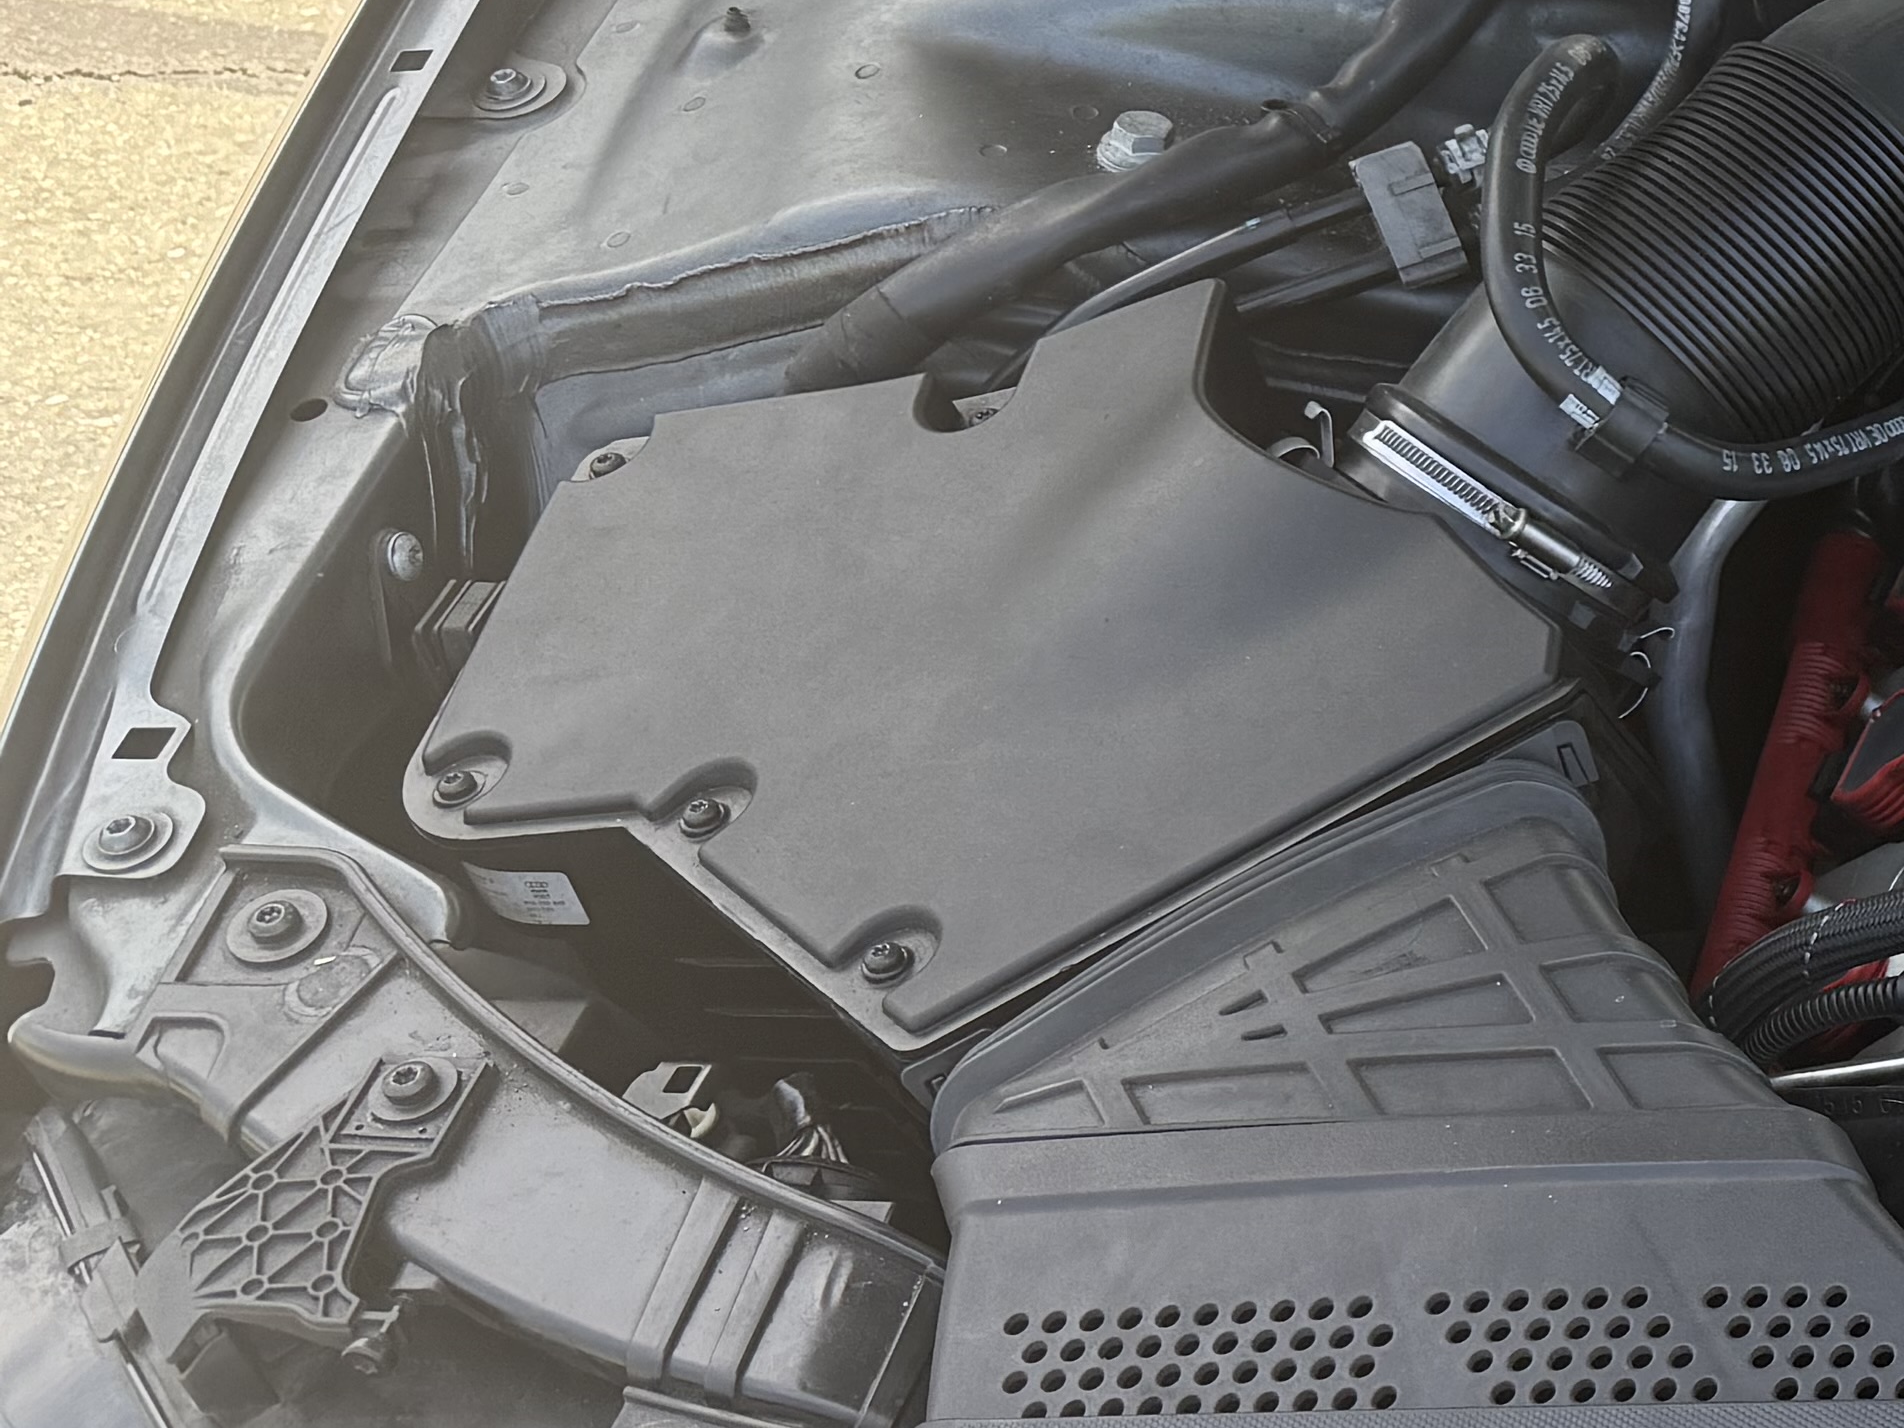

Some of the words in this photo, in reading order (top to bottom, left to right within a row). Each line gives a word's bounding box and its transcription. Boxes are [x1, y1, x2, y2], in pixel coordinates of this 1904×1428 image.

[1513, 222, 1537, 239] 15
[1514, 252, 1538, 274] 33
[1722, 448, 1739, 473] 15
[1751, 451, 1773, 474] 33
